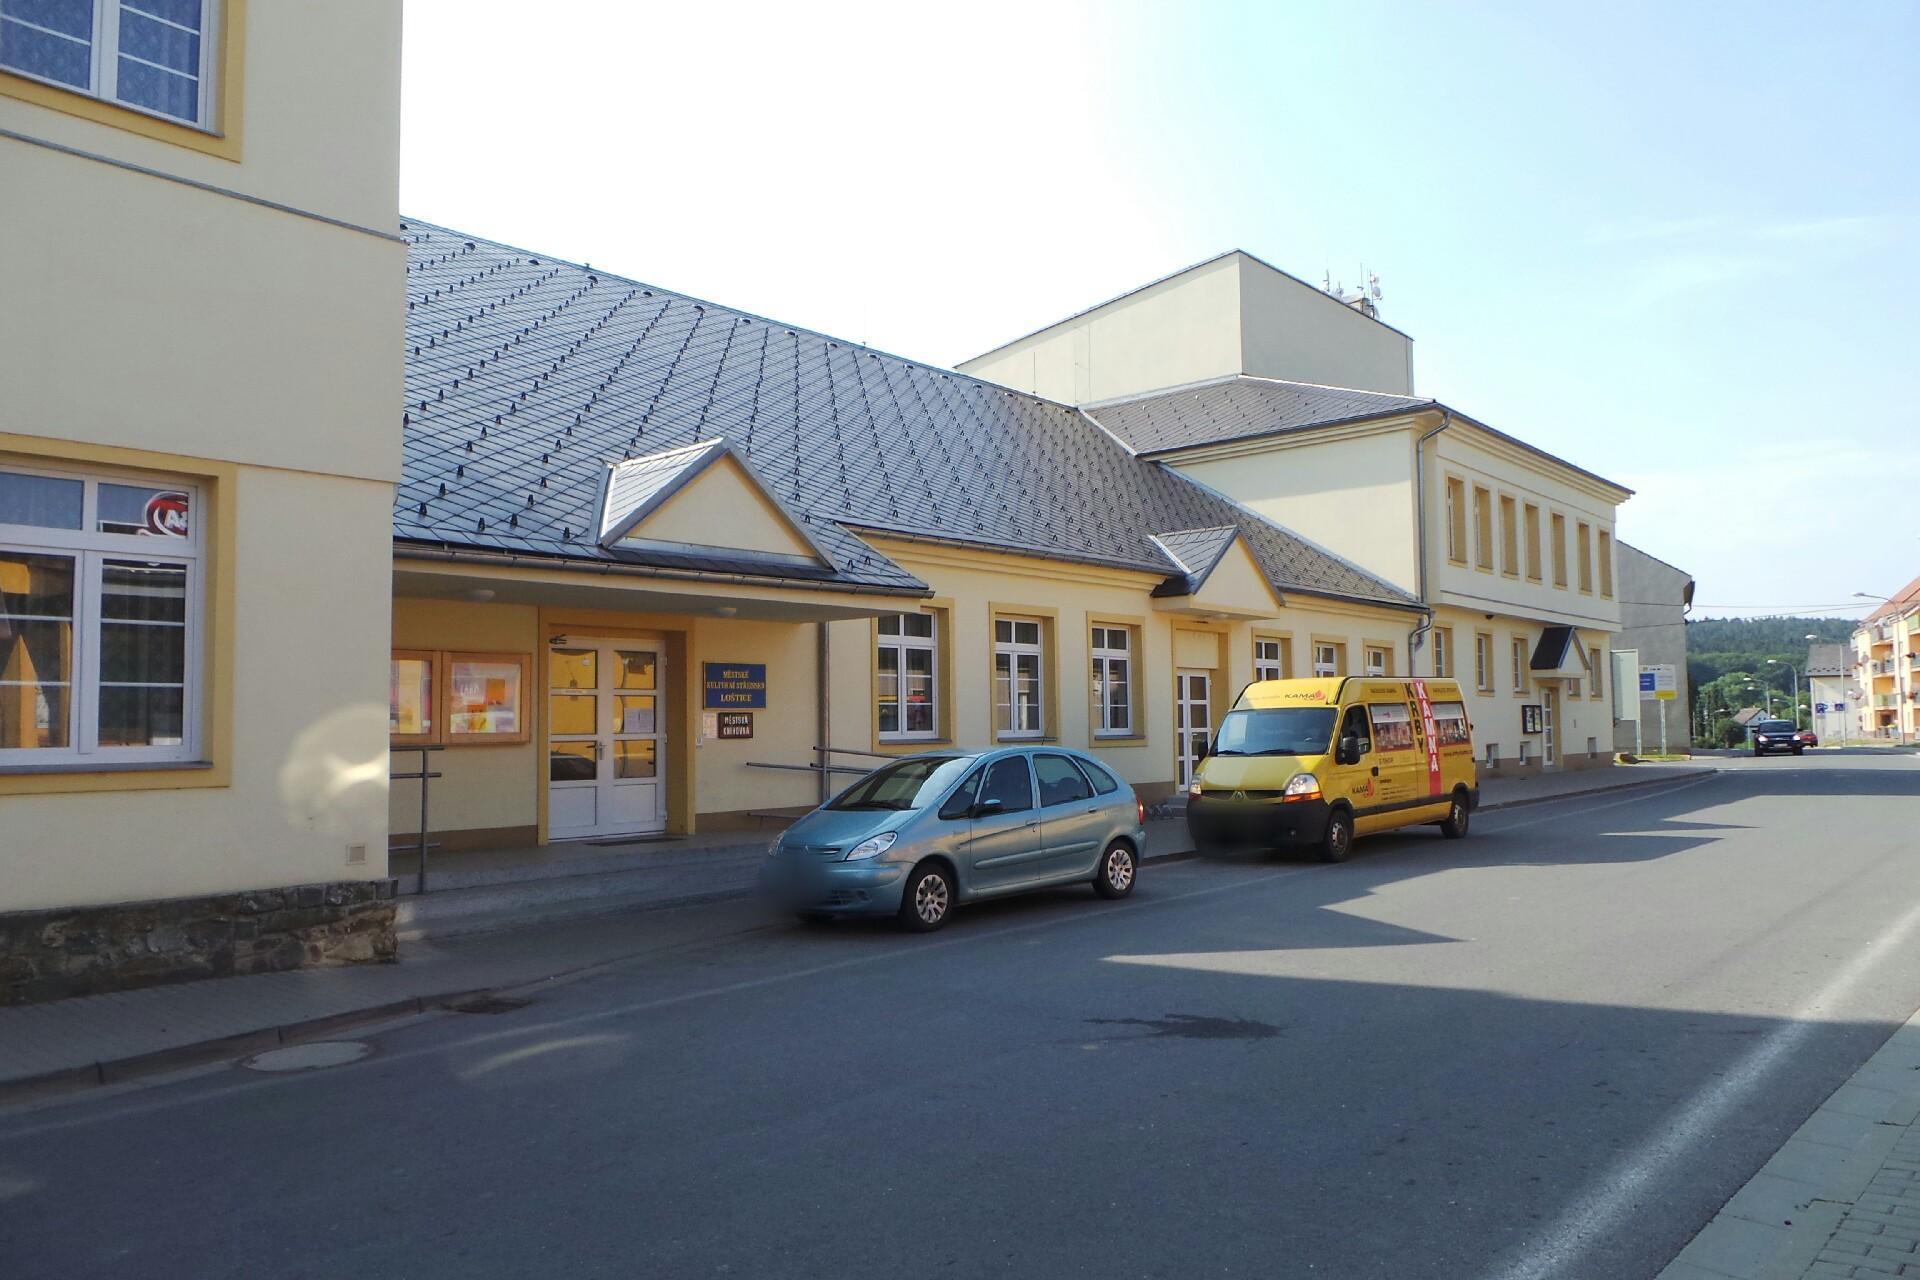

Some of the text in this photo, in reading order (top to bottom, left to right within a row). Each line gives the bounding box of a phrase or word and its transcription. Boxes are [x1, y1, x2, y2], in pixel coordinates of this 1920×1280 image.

[720, 693, 752, 702] LOŠTICE
[1284, 692, 1316, 701] KAMA
[724, 714, 749, 725] MĚSTSKÁ
[1404, 683, 1424, 754] KRBY
[723, 725, 750, 736] KNIHOVNA
[1415, 682, 1439, 772] KAMNA
[1351, 783, 1369, 795] KAMA
